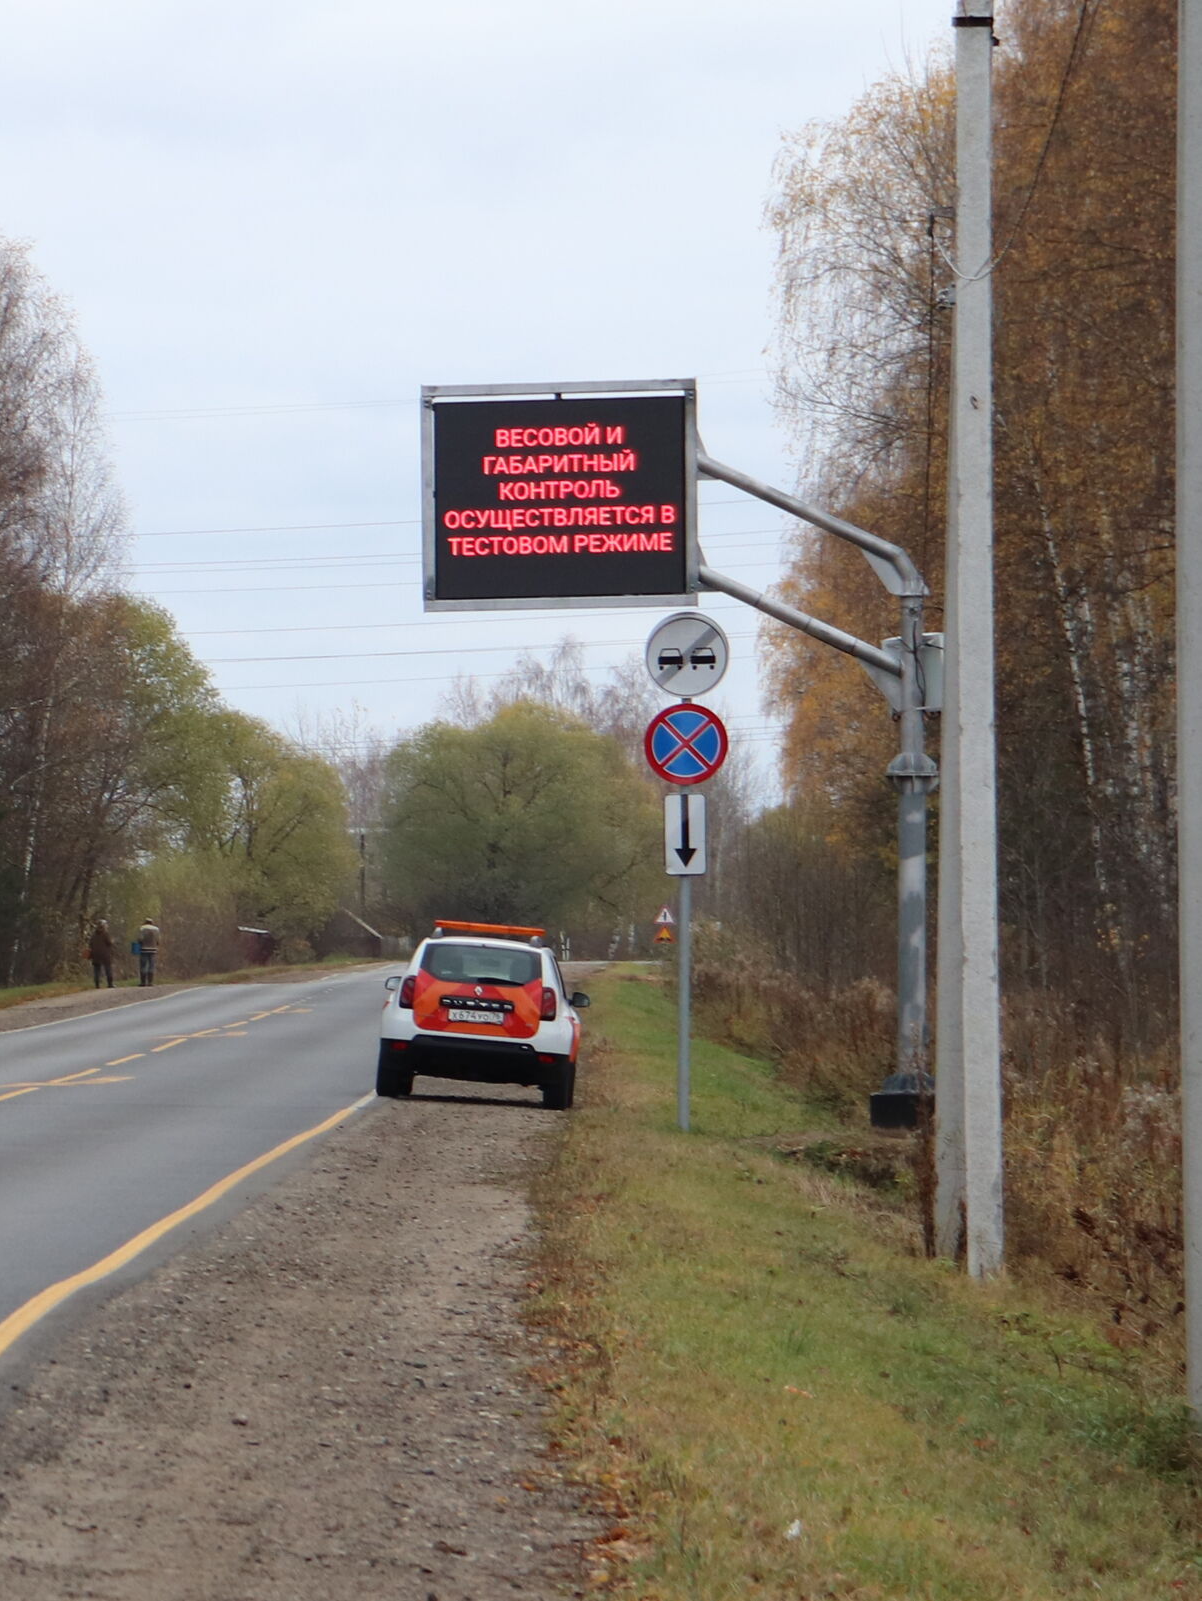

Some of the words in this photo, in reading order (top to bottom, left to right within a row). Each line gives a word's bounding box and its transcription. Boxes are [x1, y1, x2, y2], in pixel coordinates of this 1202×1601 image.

[496, 423, 600, 448] ВЕСОВОЙ
[606, 426, 623, 445] И
[483, 449, 636, 475] ГАБАРИТНЫЙ
[499, 479, 621, 501] КОНТРОЛЬ
[444, 505, 655, 531] ОСУЩЕСТВЛЯЕТСЯ
[660, 505, 676, 524] В
[447, 535, 569, 556] ТЕСТОВОМ
[573, 532, 673, 553] РЕЖИМЕ
